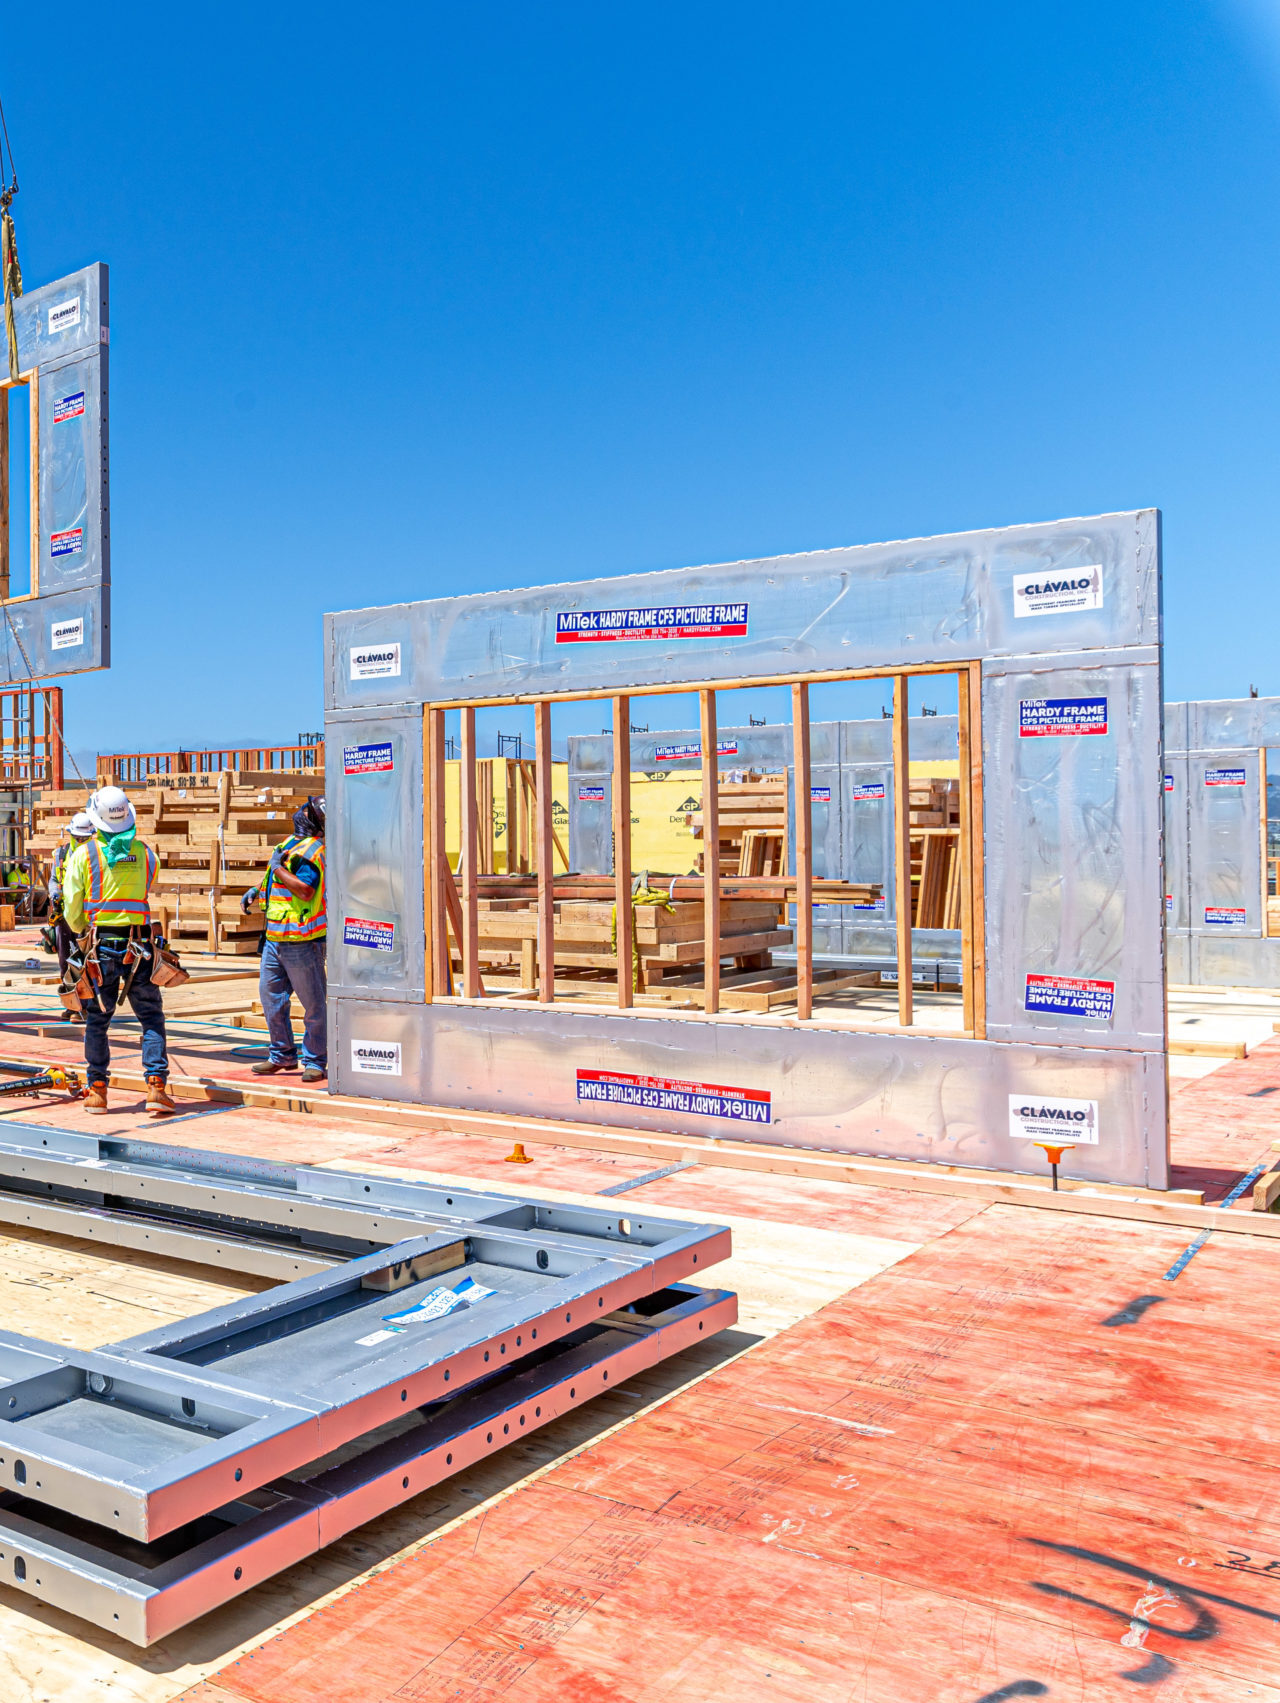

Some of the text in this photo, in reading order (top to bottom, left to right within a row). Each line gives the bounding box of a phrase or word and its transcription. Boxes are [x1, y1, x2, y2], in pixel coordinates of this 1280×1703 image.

[559, 604, 746, 630] MiTek HARDY FRAME CFS PICTURE FRAME
[1022, 705, 1105, 717] HARDY FRAME
[1022, 715, 1105, 725] CFS PICTURE FRAME
[345, 749, 391, 760] HARDY FRAME
[682, 802, 698, 812] GP
[345, 932, 392, 945] FRAME HARDY
[1028, 986, 1058, 995] FRAME
[1059, 989, 1094, 1000] PICTURE
[1028, 994, 1111, 1011] HARDY FRAME
[1085, 1009, 1111, 1019] MiTek
[671, 1085, 693, 1093] DUCTILITY
[579, 1082, 767, 1122] MiTek HARDY FRAME CFS PICTURE FRAME
